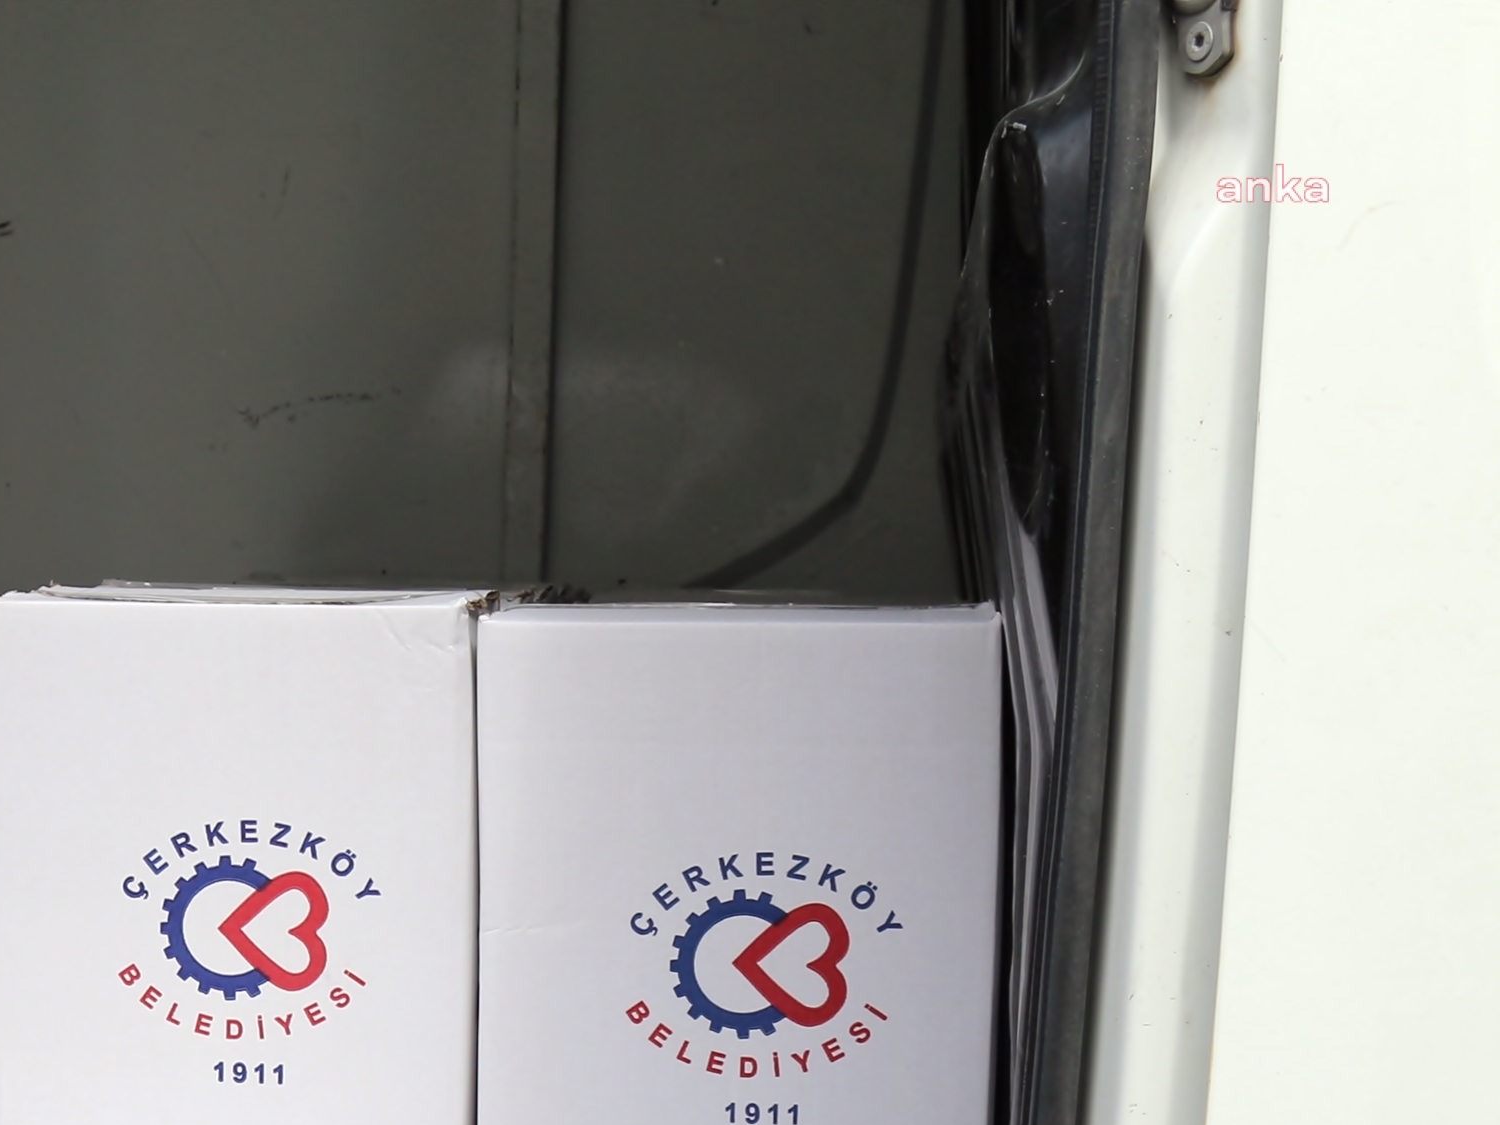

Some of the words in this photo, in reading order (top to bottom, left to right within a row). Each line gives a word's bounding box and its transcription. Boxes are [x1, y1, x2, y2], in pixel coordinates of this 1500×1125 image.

[121, 819, 383, 901] ÇERKEZKÖY
[629, 851, 904, 937] ÇERKEZKÖY
[117, 963, 367, 1041] BELEDİYESİ
[625, 1000, 889, 1079] BELEDİYESİ
[212, 1061, 285, 1086] 1911
[724, 1101, 800, 1125] 1911
